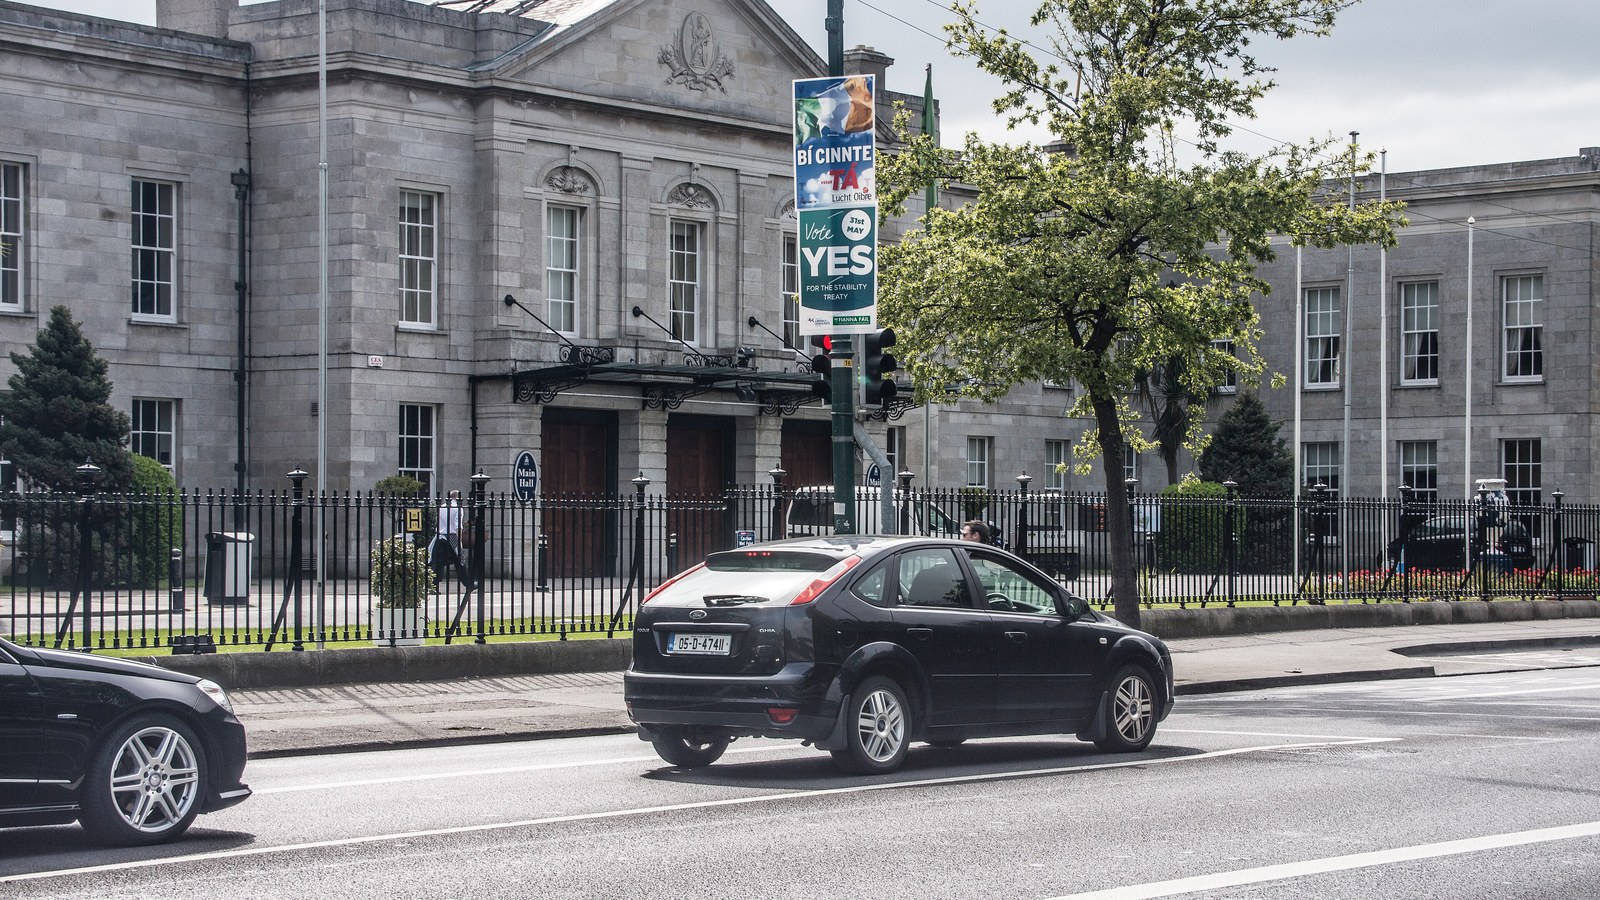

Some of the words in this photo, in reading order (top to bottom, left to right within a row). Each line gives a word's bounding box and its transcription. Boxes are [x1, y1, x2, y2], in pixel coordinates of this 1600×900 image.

[797, 145, 813, 165] BÍ
[815, 145, 872, 164] CINNTE
[829, 162, 859, 191] TÁ
[832, 194, 851, 202] Lucht
[853, 192, 872, 201] Oibre
[849, 217, 865, 225] 31st
[805, 222, 834, 240] Vote
[847, 226, 864, 234] MAY
[801, 245, 873, 277] YES
[833, 283, 868, 291] STABILITY
[823, 293, 848, 301] TREATY
[518, 468, 535, 477] Main
[519, 479, 534, 487] Hall
[869, 477, 880, 486] Mai
[678, 637, 725, 651] 05-D-47411
